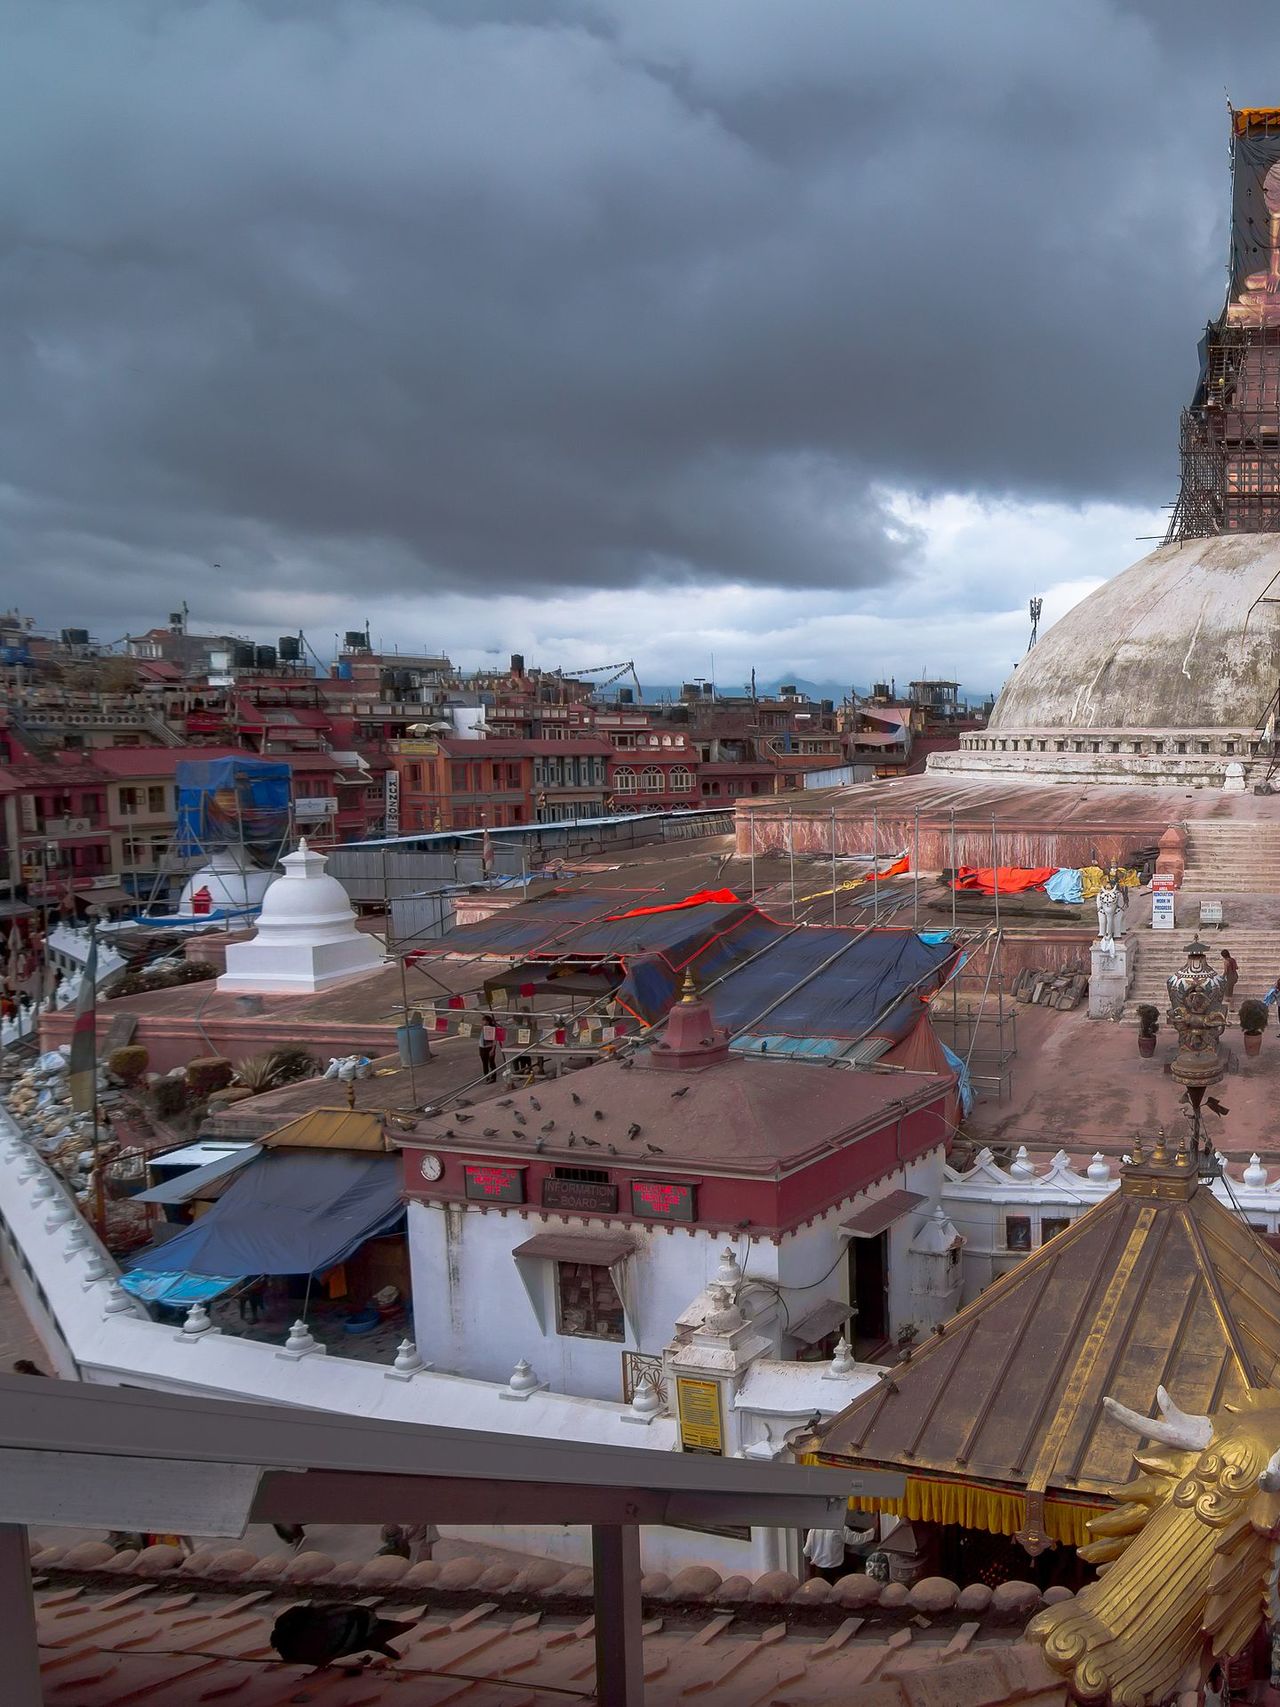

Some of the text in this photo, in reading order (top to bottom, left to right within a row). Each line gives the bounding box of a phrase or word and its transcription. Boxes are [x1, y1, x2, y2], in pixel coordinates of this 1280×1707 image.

[388, 781, 398, 820] KUNZOM
[544, 1180, 615, 1198] INFORMATION
[560, 1197, 598, 1209] BOARD
